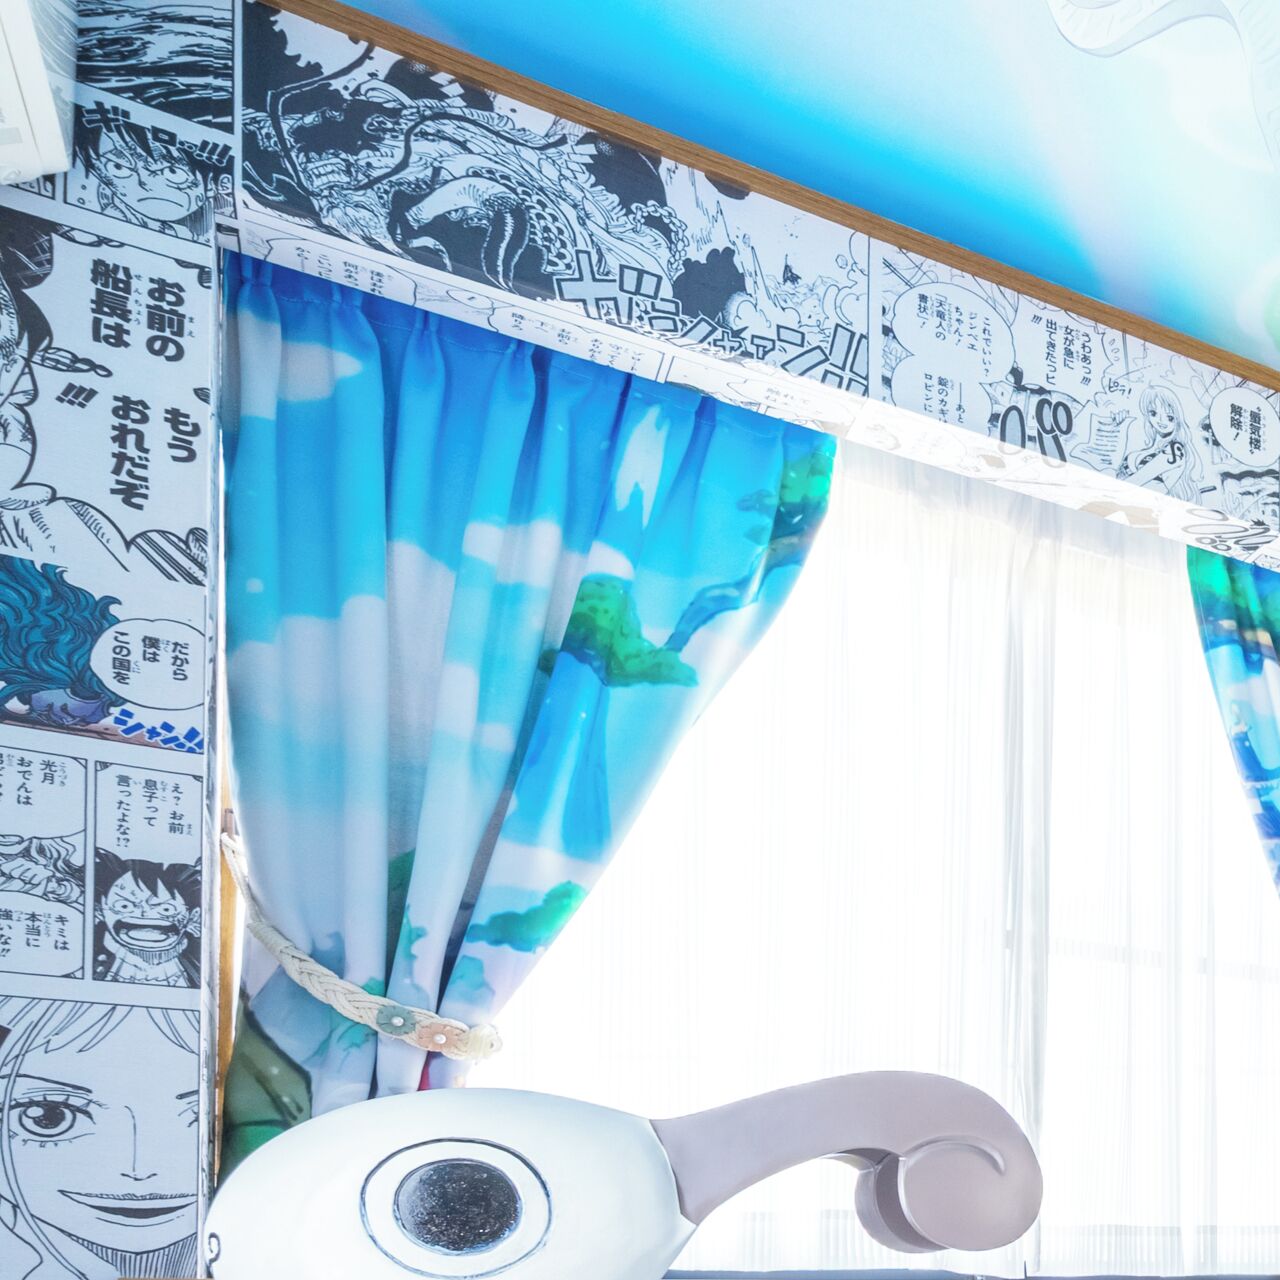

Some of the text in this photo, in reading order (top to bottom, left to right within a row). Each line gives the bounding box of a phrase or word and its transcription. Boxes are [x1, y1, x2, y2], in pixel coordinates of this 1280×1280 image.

[90, 257, 133, 350] 船長は
[145, 275, 187, 362] お前の
[110, 393, 150, 511] おれだぞ
[163, 406, 200, 463] もう
[113, 630, 131, 686] この国を
[141, 634, 160, 663] 僕は
[170, 640, 191, 682] だから
[16, 755, 34, 807] おでんは
[40, 759, 56, 786] 光月
[142, 778, 159, 828] 息子って
[24, 911, 42, 948] 本当に
[53, 913, 70, 951] キミは
